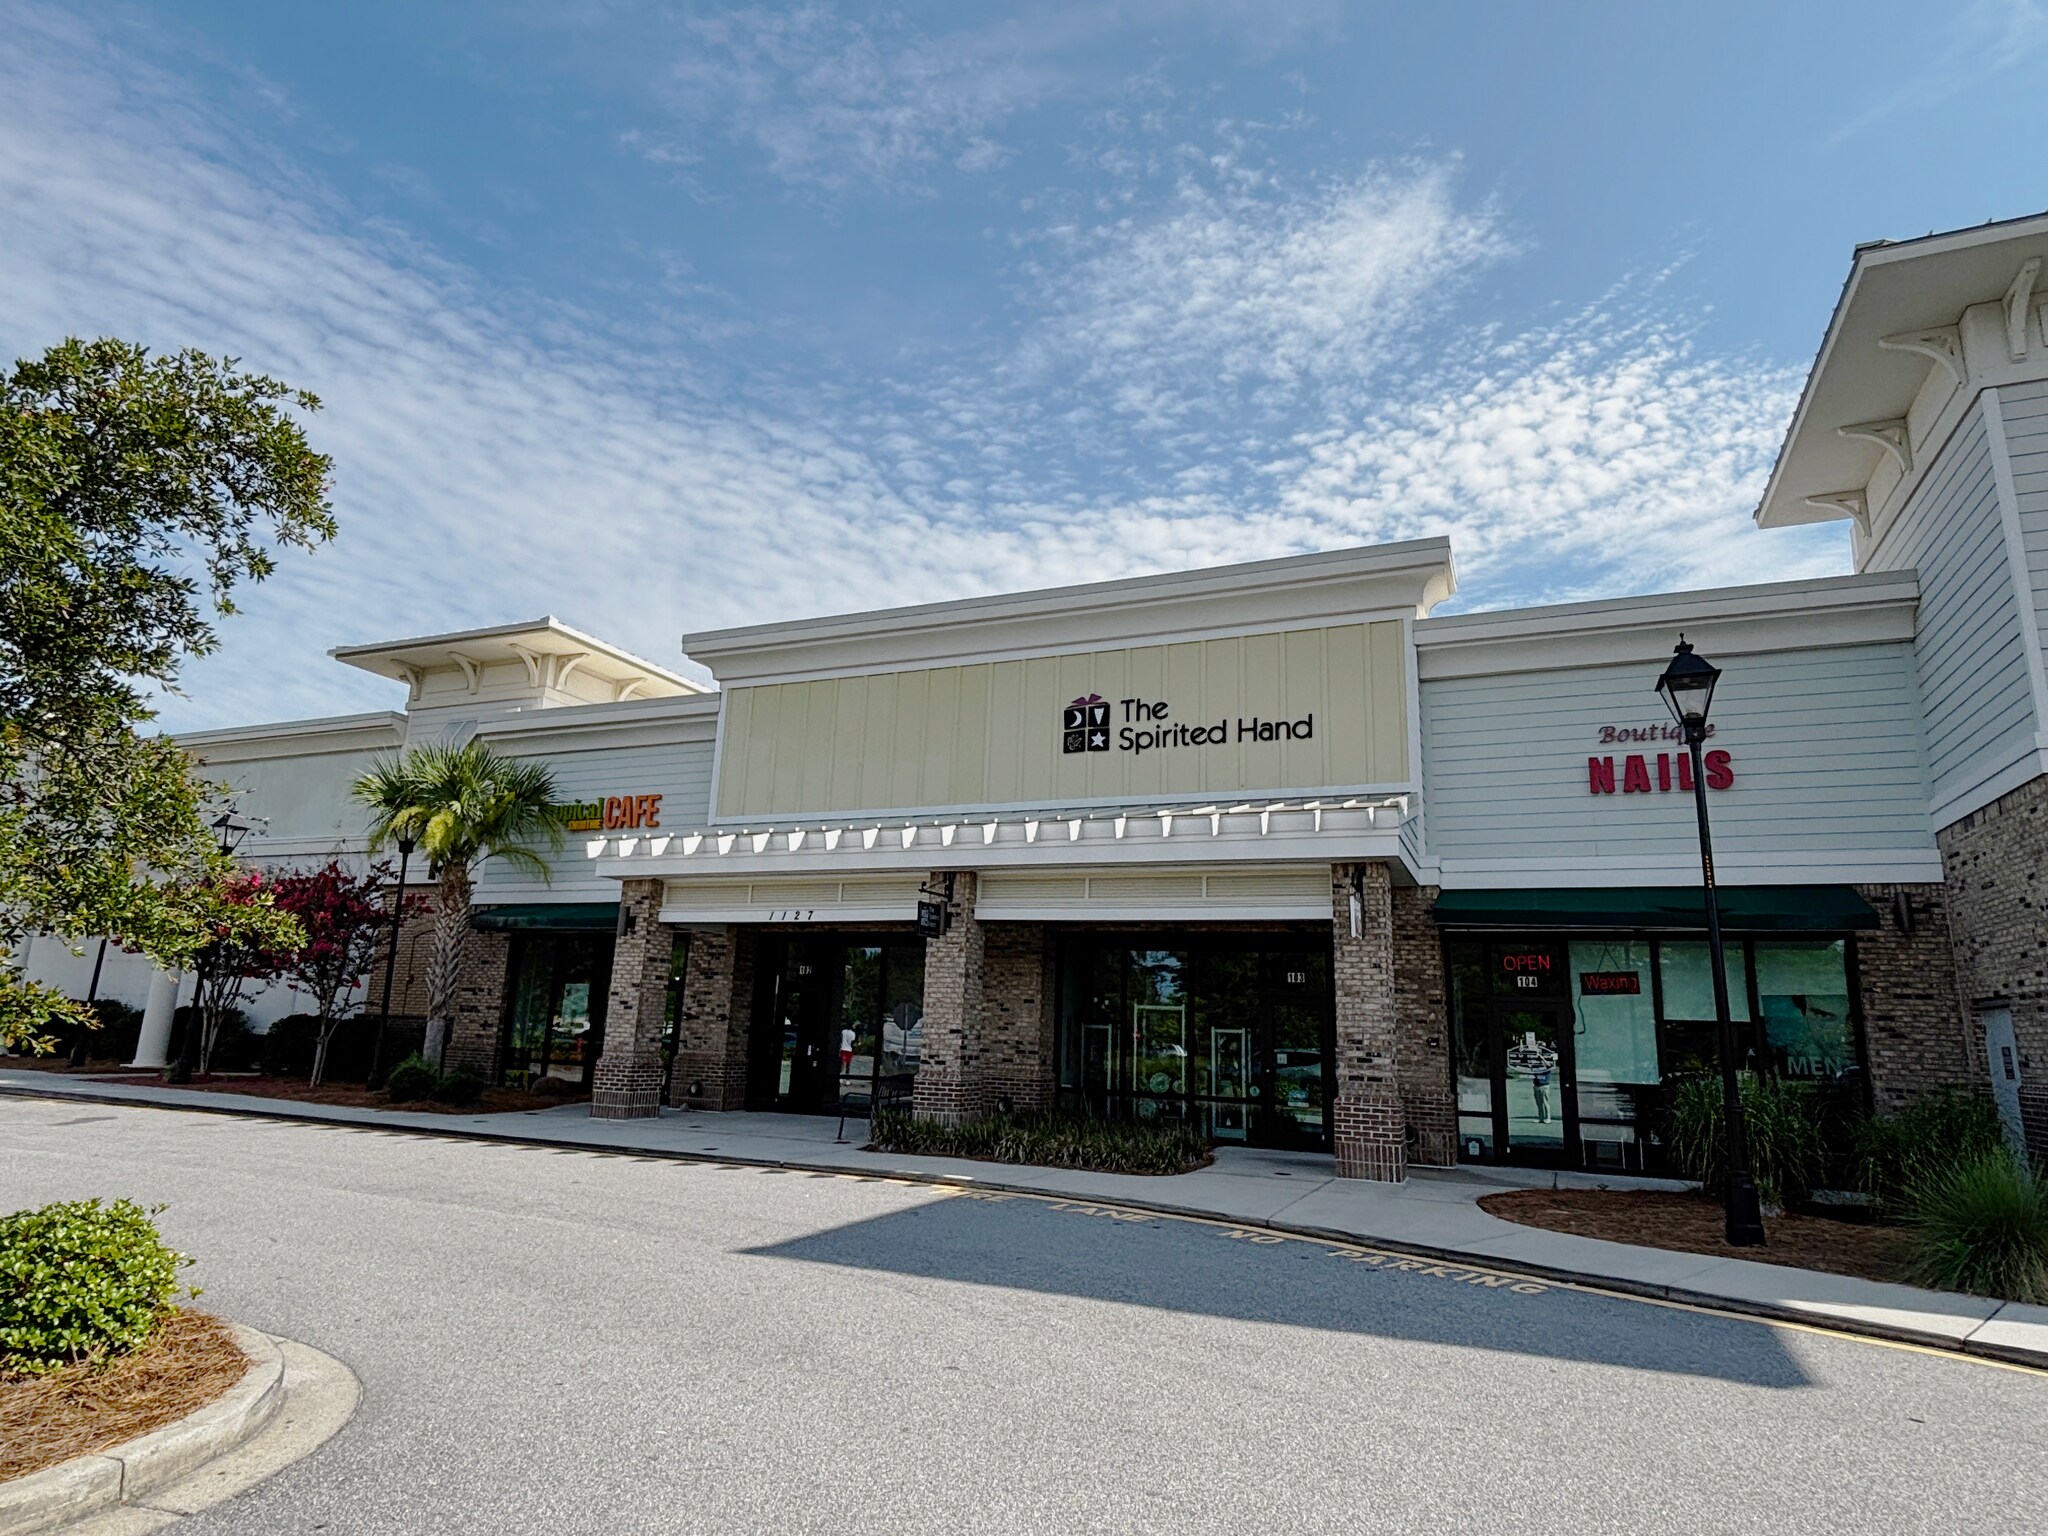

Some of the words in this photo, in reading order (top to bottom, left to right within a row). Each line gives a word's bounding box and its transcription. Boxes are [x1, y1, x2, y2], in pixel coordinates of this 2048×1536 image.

[1120, 698, 1168, 722] The
[1118, 719, 1227, 755] Spirited
[1237, 714, 1313, 743] Hand
[1598, 722, 1716, 746] Boutiqe
[1588, 749, 1734, 794] NAILS
[604, 794, 663, 829] CAFE
[768, 910, 814, 921] 1127
[1502, 955, 1551, 972] OPEN
[1517, 976, 1538, 988] 104
[1584, 974, 1639, 993] Waxing
[1786, 1056, 1843, 1077] MEN
[1047, 1203, 1158, 1223] LANE
[1219, 1229, 1285, 1246] NO
[1326, 1248, 1551, 1295] PARKING
